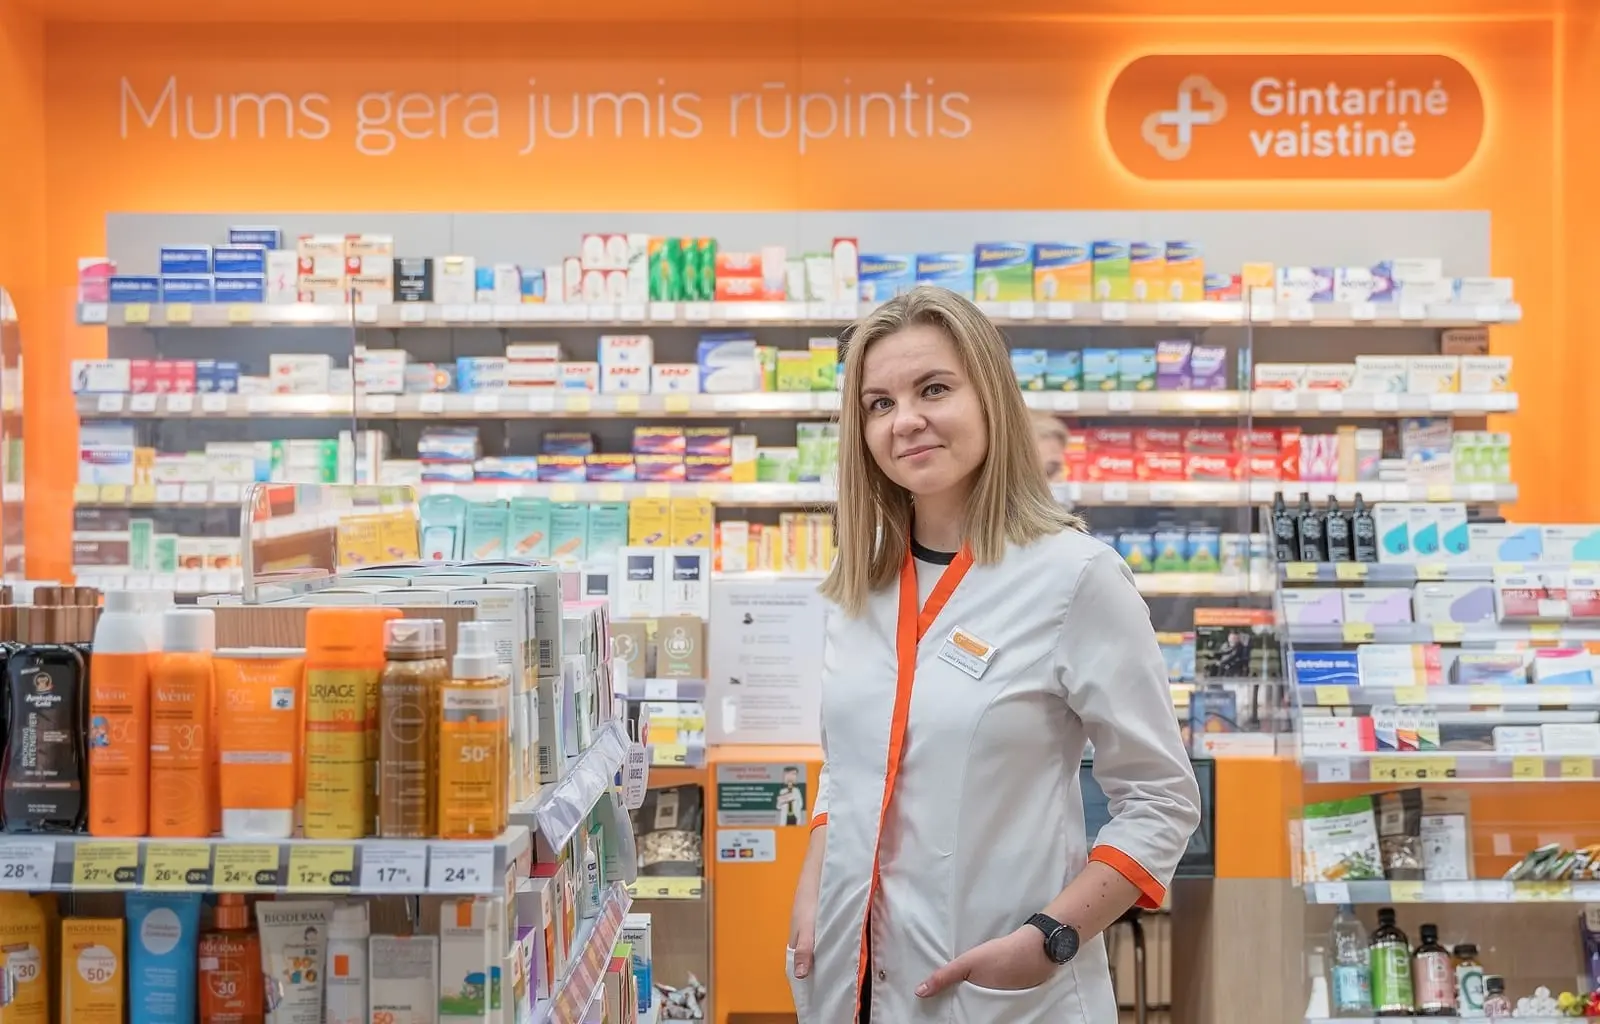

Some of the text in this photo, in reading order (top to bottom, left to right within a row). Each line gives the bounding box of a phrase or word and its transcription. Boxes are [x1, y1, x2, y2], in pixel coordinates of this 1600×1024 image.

[1250, 76, 1448, 116] Gintarinė
[119, 75, 972, 156] Mums gera jumis rūpintis
[1249, 121, 1416, 157] vaistinė
[29, 712, 38, 767] INTENSIFIER
[4, 864, 24, 878] 28
[84, 869, 99, 880] 27
[155, 870, 170, 881] 26
[225, 871, 240, 882] 24
[300, 872, 314, 883] 12
[377, 868, 397, 882] 17
[445, 868, 466, 882] 24
[264, 912, 326, 924] BIODERMA
[18, 964, 36, 978] 30
[87, 968, 112, 981] 50+
[218, 981, 237, 994] 30
